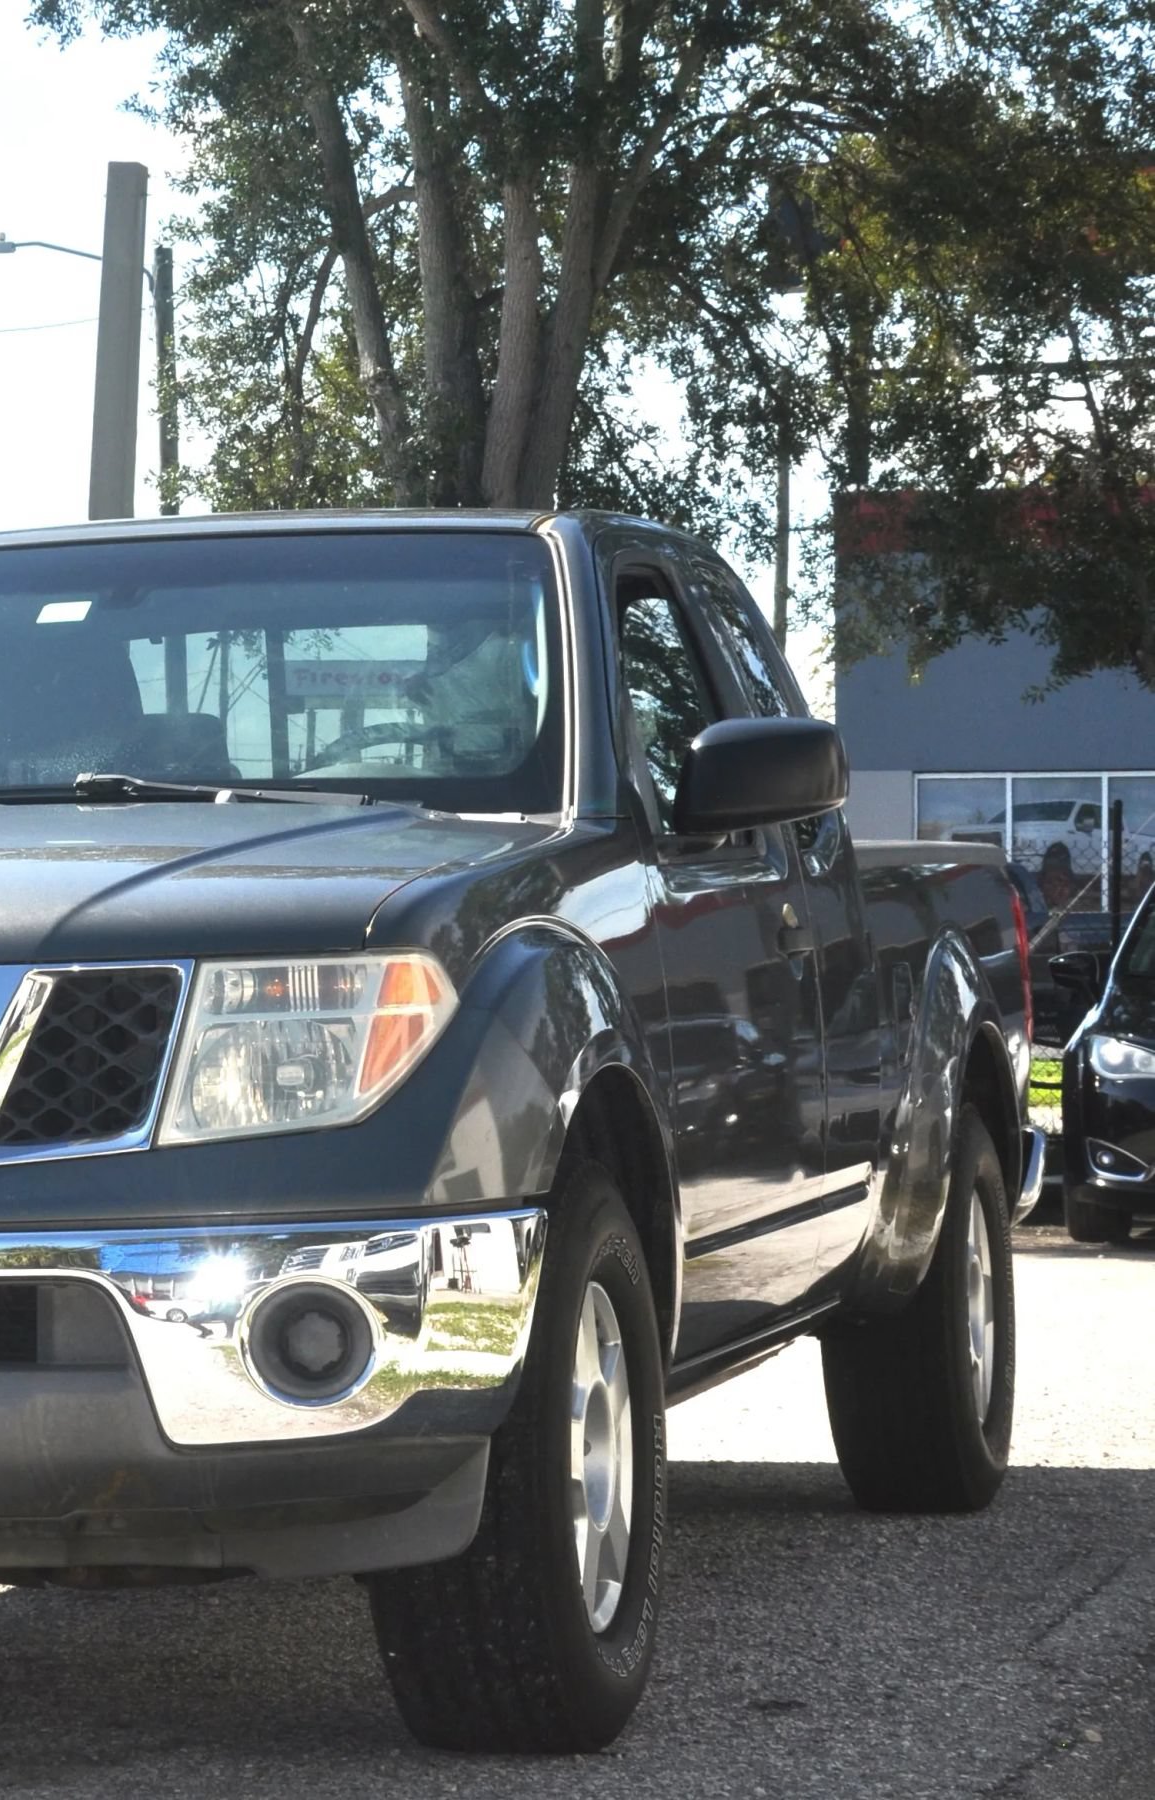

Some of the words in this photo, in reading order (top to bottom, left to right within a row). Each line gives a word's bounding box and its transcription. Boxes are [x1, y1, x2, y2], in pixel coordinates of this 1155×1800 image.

[293, 668, 410, 688] Firesto
[648, 1414, 664, 1594] Radial
[621, 1597, 654, 1671] Long
